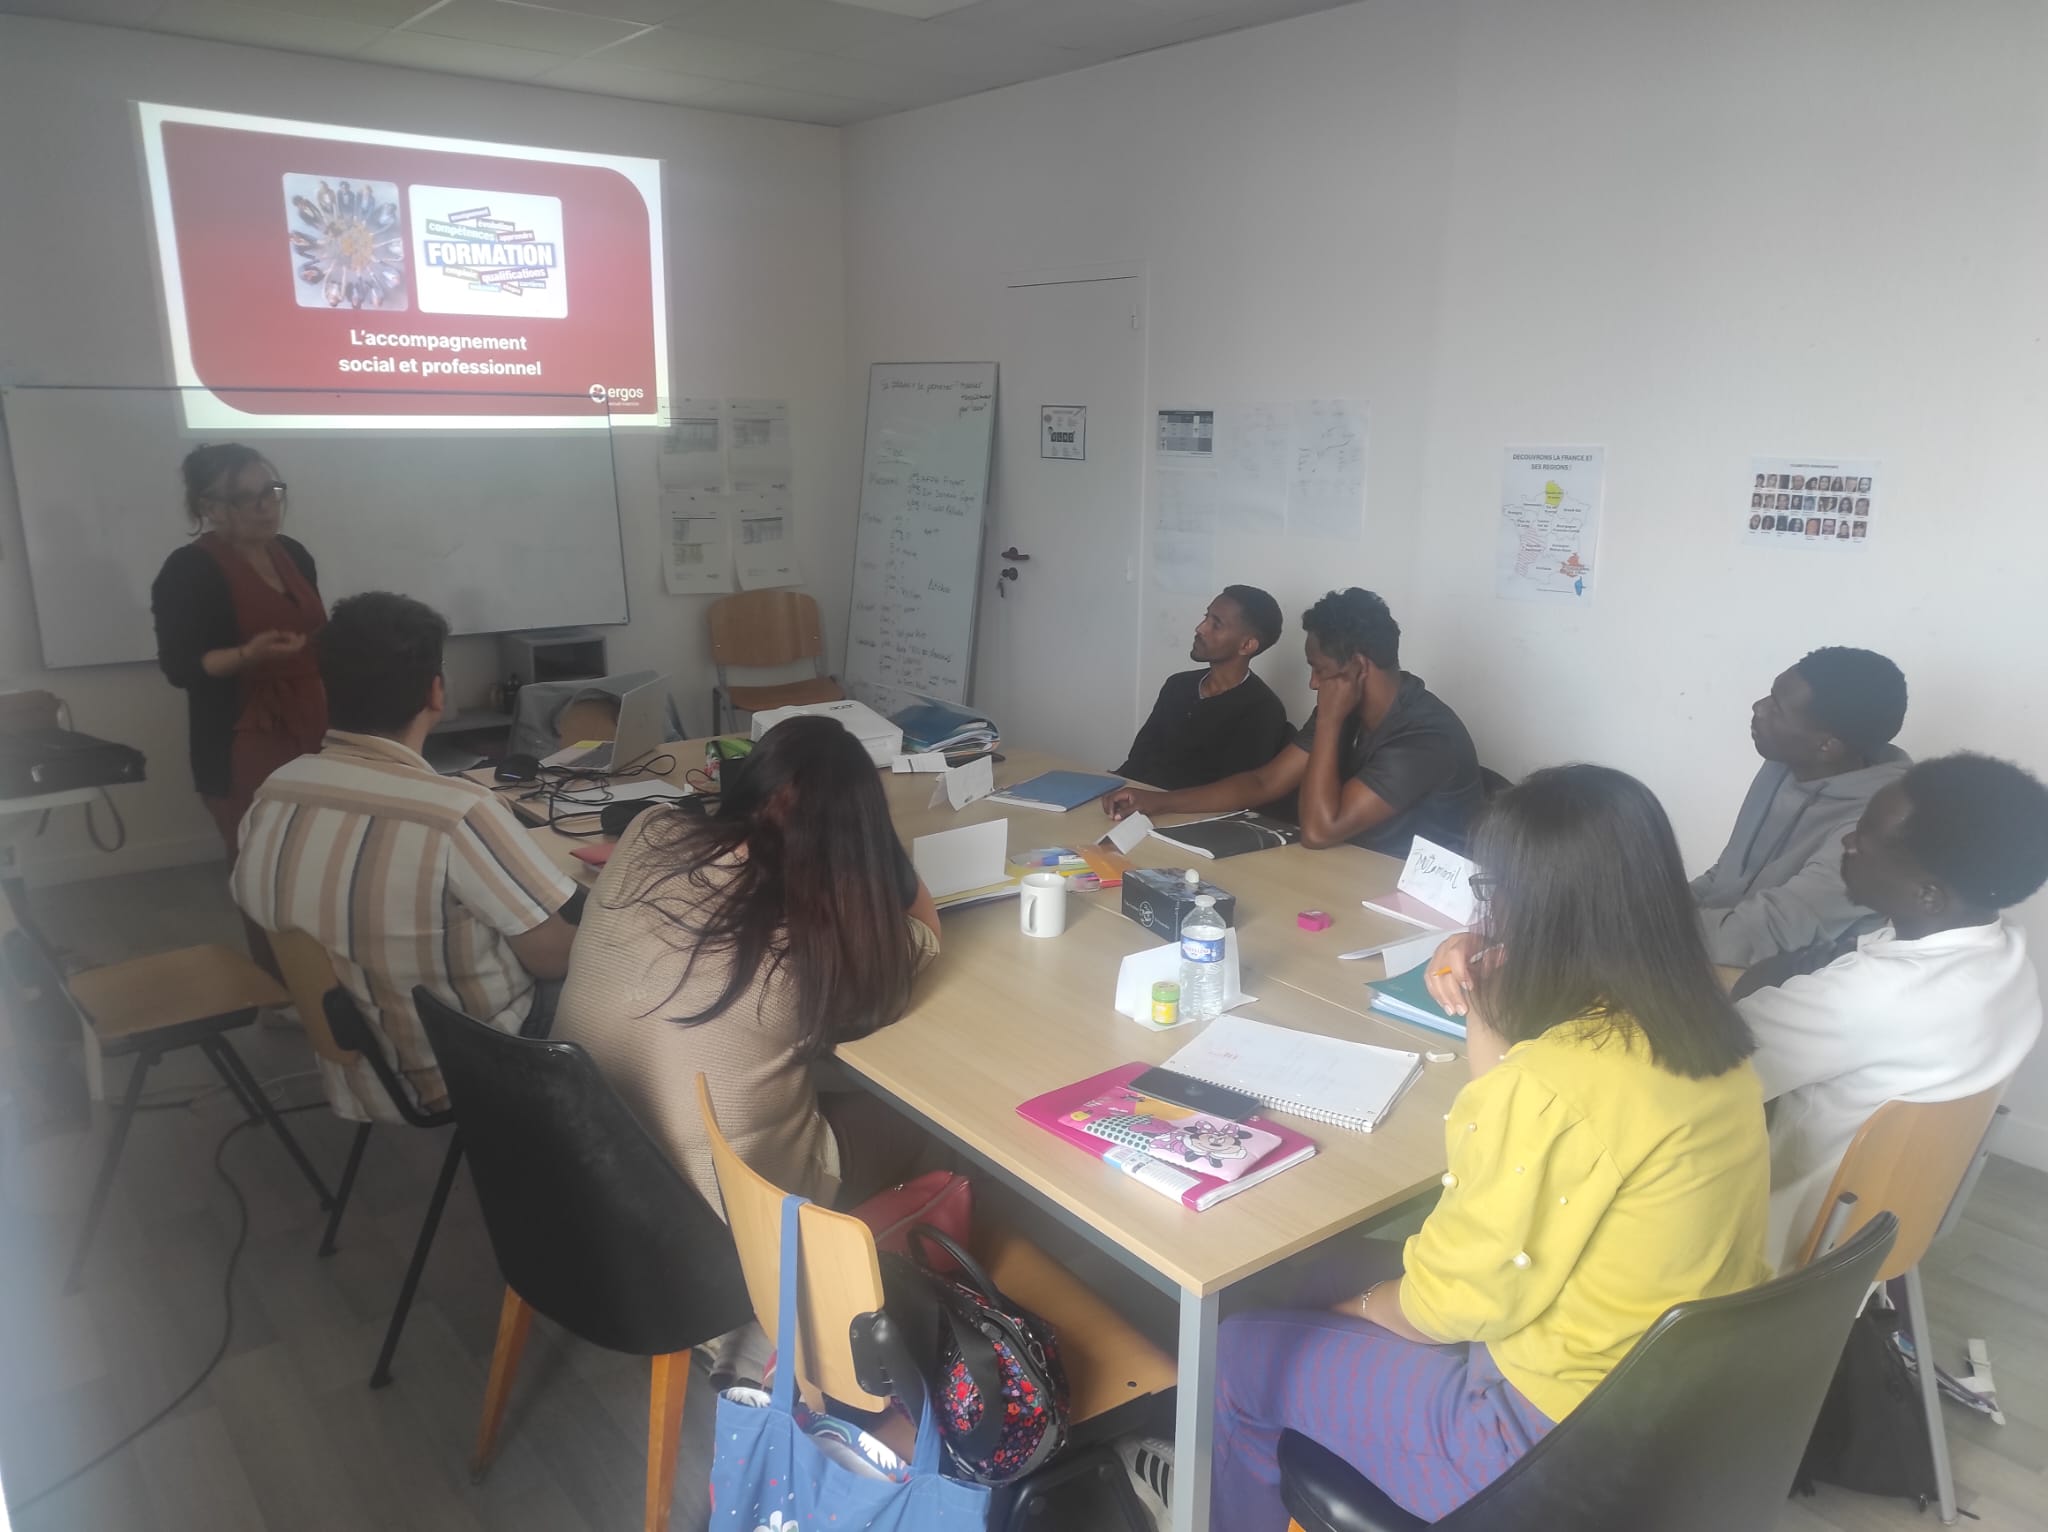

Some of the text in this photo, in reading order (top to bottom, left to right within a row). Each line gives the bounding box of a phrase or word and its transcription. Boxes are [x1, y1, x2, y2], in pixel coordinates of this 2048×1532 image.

[428, 221, 496, 241] compétences
[427, 241, 554, 267] FORMATION
[481, 267, 547, 284] qualifications
[350, 329, 528, 352] L'accompagnement
[339, 356, 542, 377] social et professionnel
[607, 387, 644, 401] ergos
